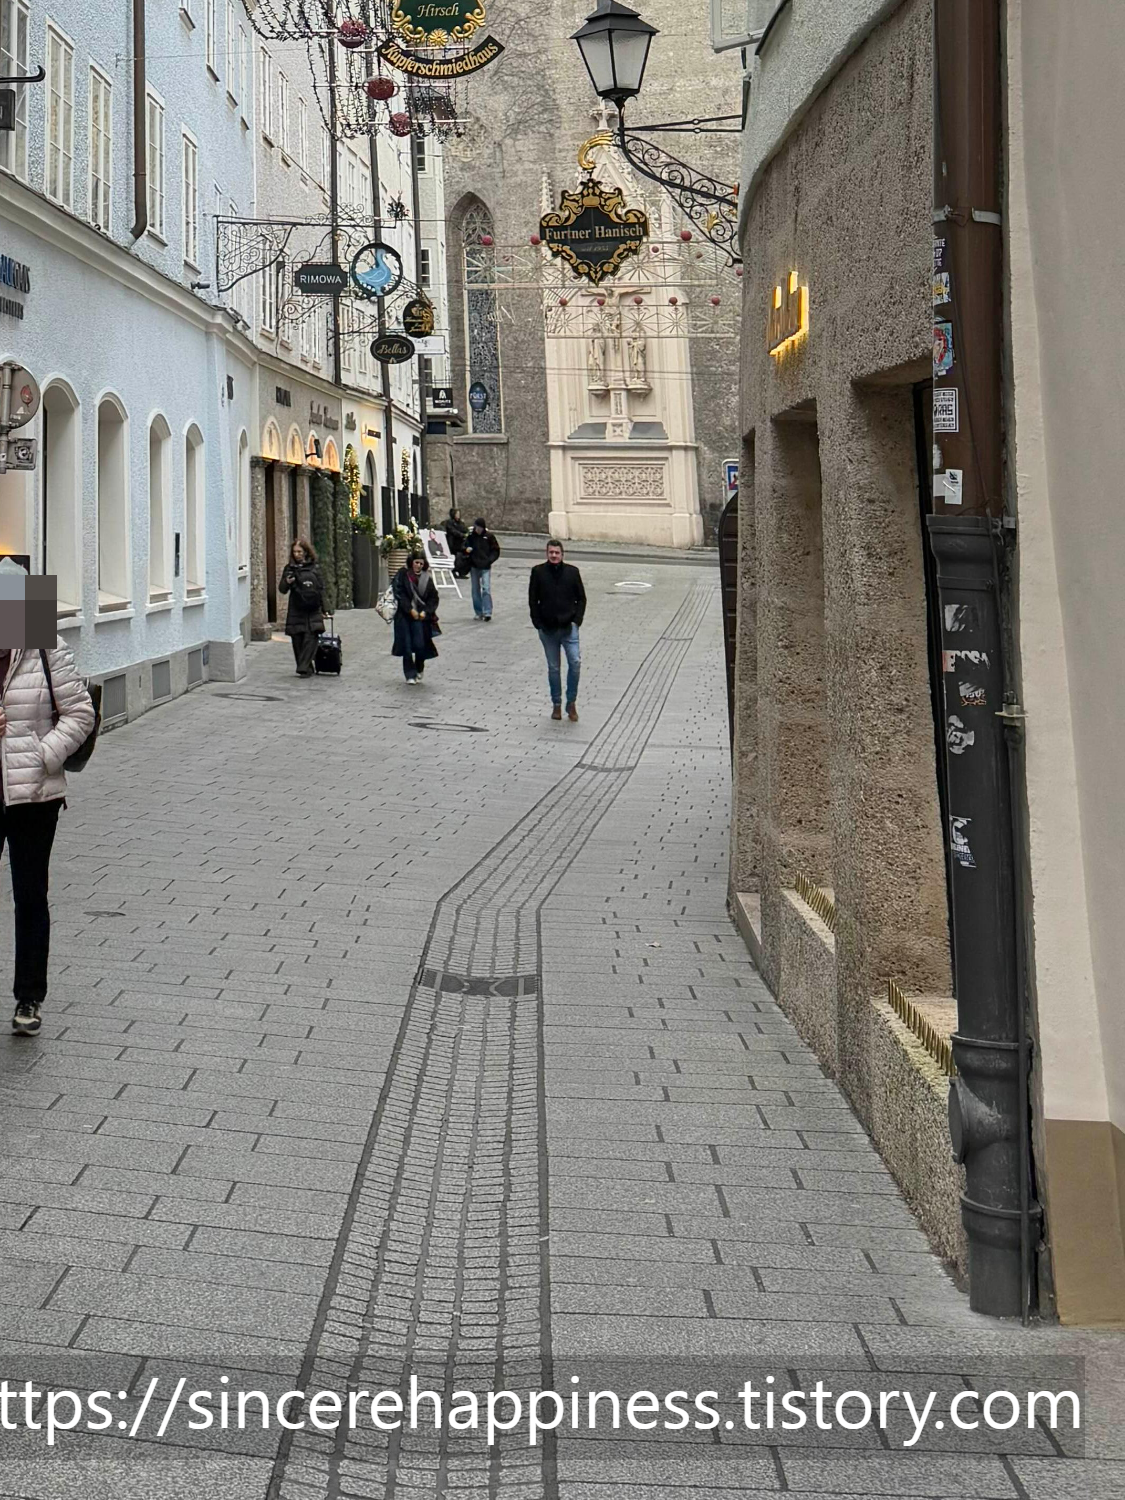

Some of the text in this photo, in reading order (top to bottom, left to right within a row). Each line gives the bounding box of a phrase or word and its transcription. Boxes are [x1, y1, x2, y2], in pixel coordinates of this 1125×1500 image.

[417, 3, 459, 18] Hirsch
[381, 42, 498, 76] Kupferschmiedhaus
[545, 225, 644, 240] Furtner Hanisch
[300, 274, 342, 284] RIMOWA
